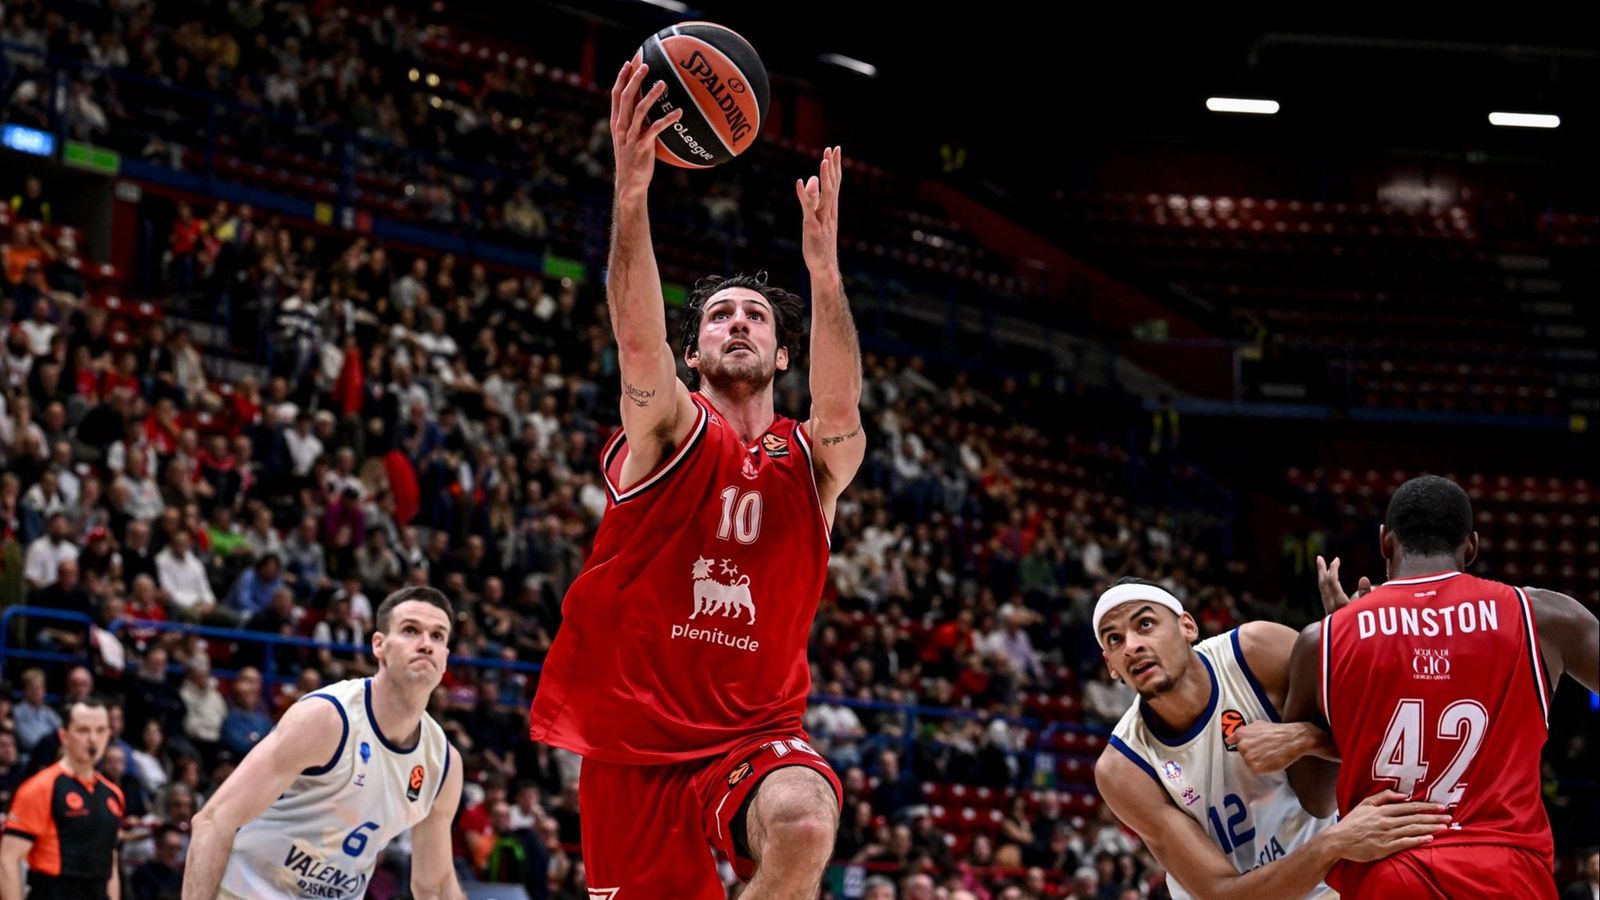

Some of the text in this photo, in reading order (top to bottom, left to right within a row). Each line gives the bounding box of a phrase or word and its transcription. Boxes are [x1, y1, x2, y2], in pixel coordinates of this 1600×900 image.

[680, 51, 751, 143] SPALDING
[661, 102, 714, 160] EoLeague
[716, 485, 762, 545] 10
[671, 623, 759, 652] plenitude
[1357, 600, 1499, 640] DUNSTON
[1372, 698, 1489, 807] 42
[342, 821, 380, 857] 6
[1208, 793, 1256, 854] 12
